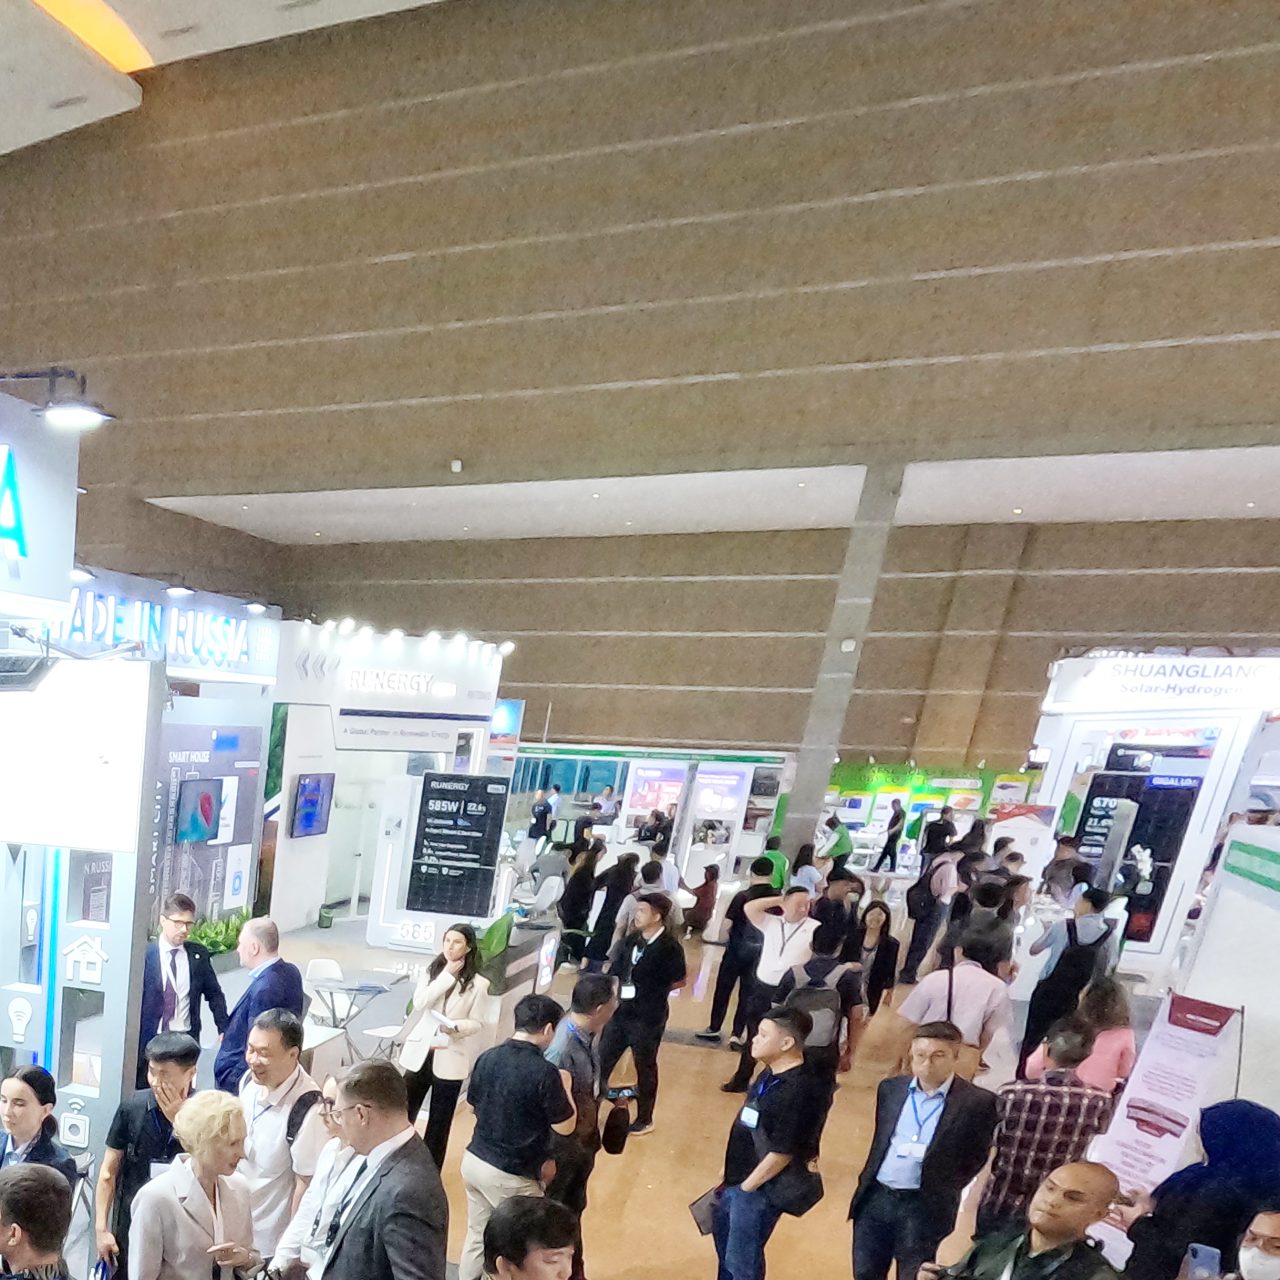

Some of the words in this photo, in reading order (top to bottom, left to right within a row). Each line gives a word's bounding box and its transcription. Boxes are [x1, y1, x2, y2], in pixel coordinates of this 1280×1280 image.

[43, 587, 126, 645] ADE
[133, 600, 164, 652] IN
[170, 607, 249, 663] RUSSIA
[349, 670, 435, 694] RUNERGY
[168, 750, 189, 762] SMART
[190, 750, 210, 762] HOUSE
[430, 781, 470, 791] RUNERGY
[428, 799, 459, 813] 585W
[1092, 797, 1118, 808] 670
